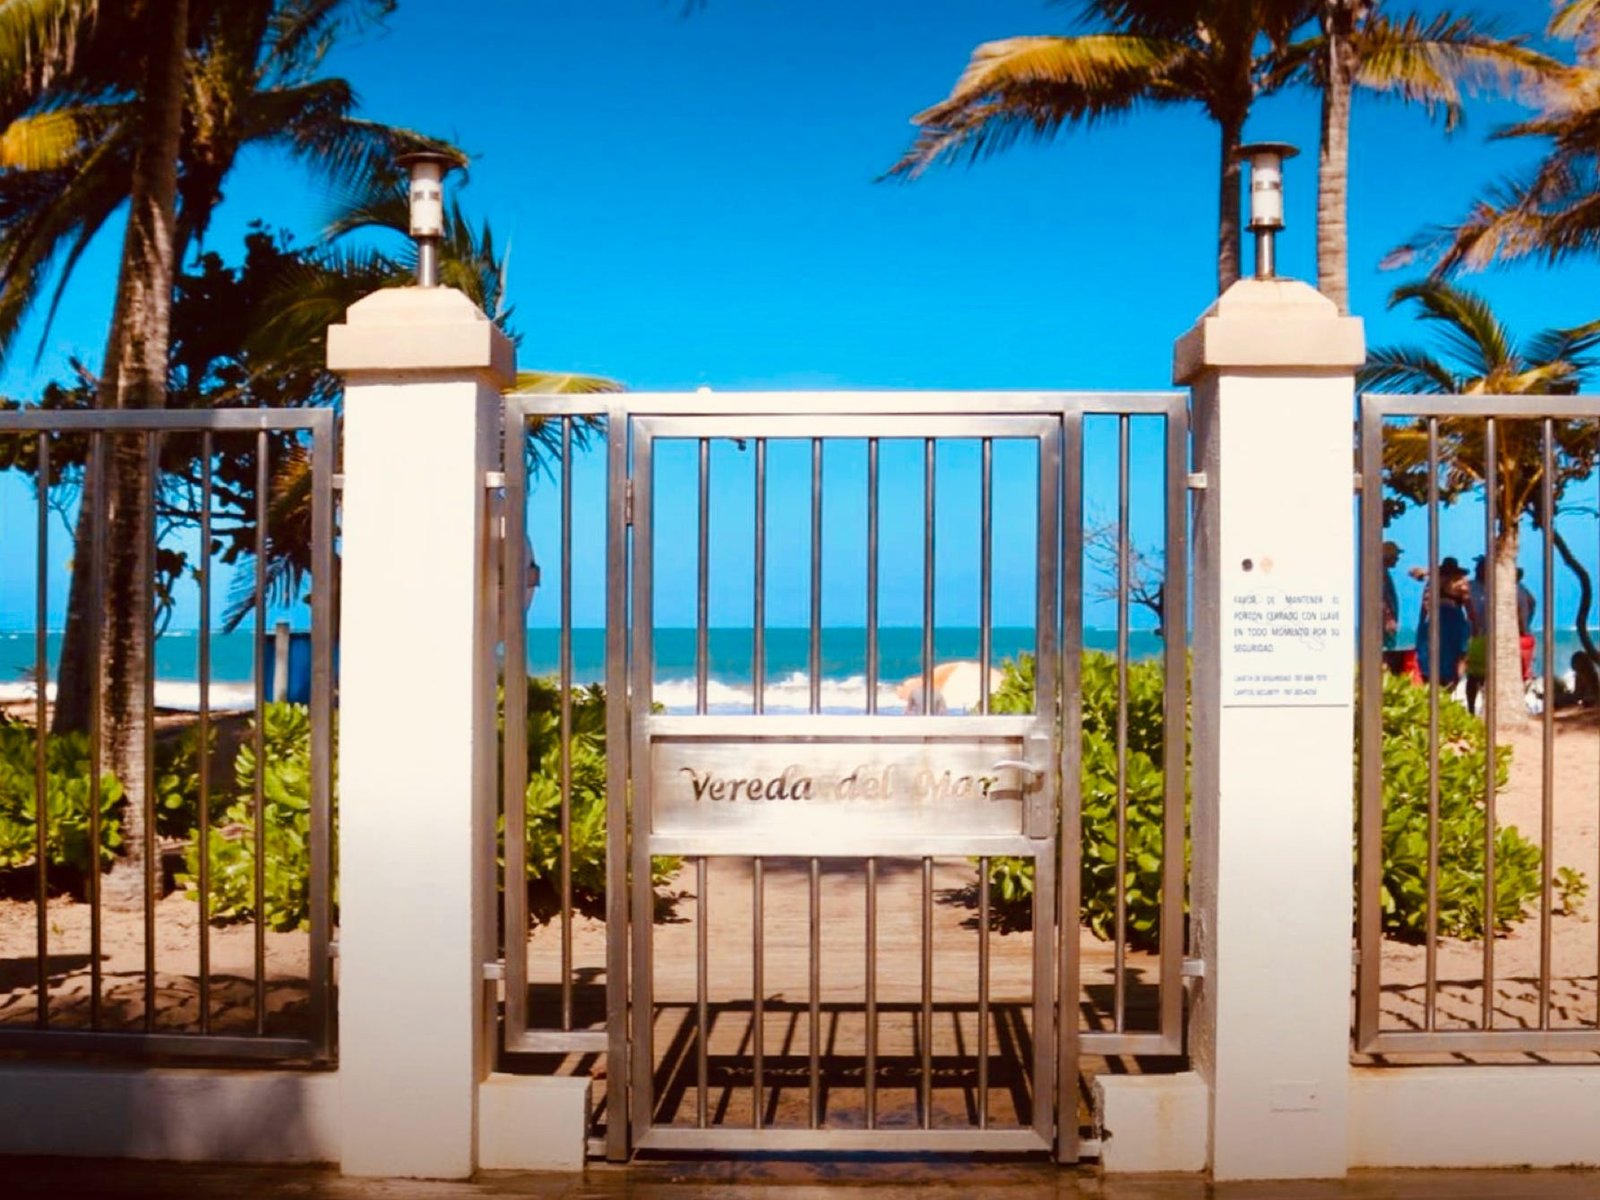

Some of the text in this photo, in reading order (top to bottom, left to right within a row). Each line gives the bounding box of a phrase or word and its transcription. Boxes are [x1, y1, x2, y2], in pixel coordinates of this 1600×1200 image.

[1285, 595, 1323, 604] MANTENER
[1266, 611, 1298, 621] CERRADO
[1301, 611, 1317, 621] CON
[1320, 611, 1340, 621] LLAVE
[1233, 627, 1340, 637] EN TODO MOMENTO POR SU
[679, 764, 999, 801] Vereda del Mar
